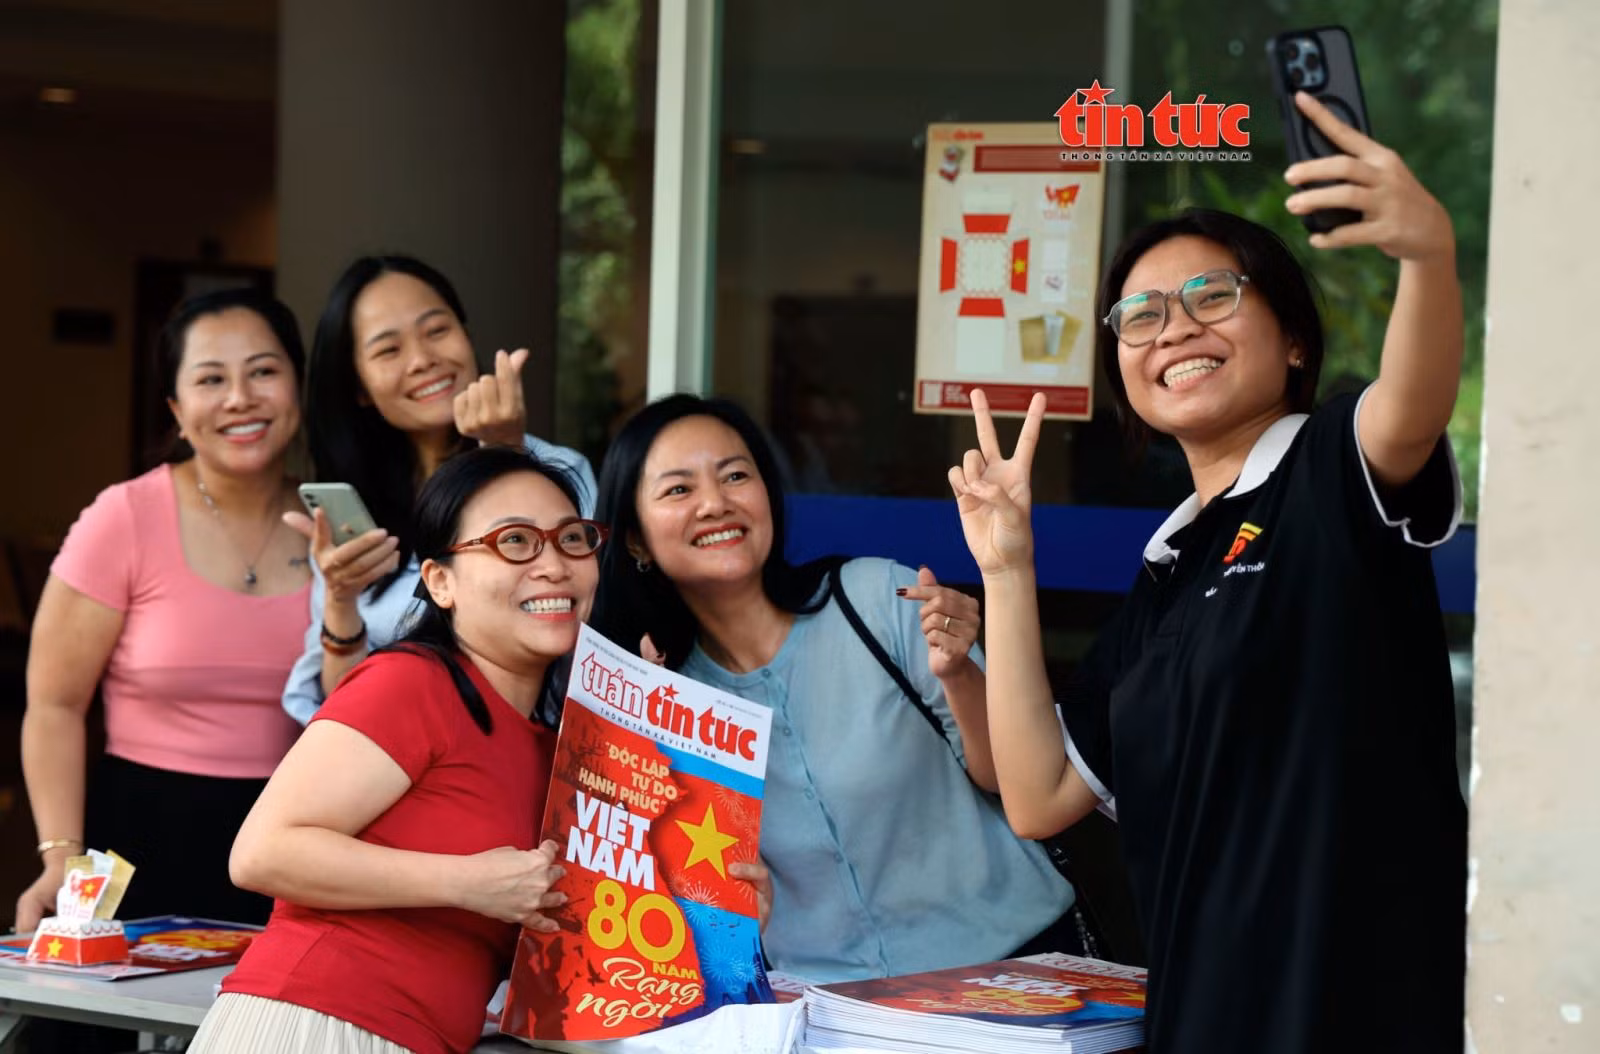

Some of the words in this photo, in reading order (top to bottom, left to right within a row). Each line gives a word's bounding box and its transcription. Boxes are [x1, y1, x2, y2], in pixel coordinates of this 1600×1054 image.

[645, 683, 695, 740] tin
[697, 706, 758, 761] tức
[696, 746, 717, 759] NAM
[578, 767, 617, 798] HẠNH
[653, 780, 678, 800] DO
[576, 789, 651, 852] VIỆT
[566, 825, 656, 892] NAM
[587, 879, 686, 963] 80
[602, 956, 702, 1006] Rạng
[575, 992, 679, 1028] ngời
